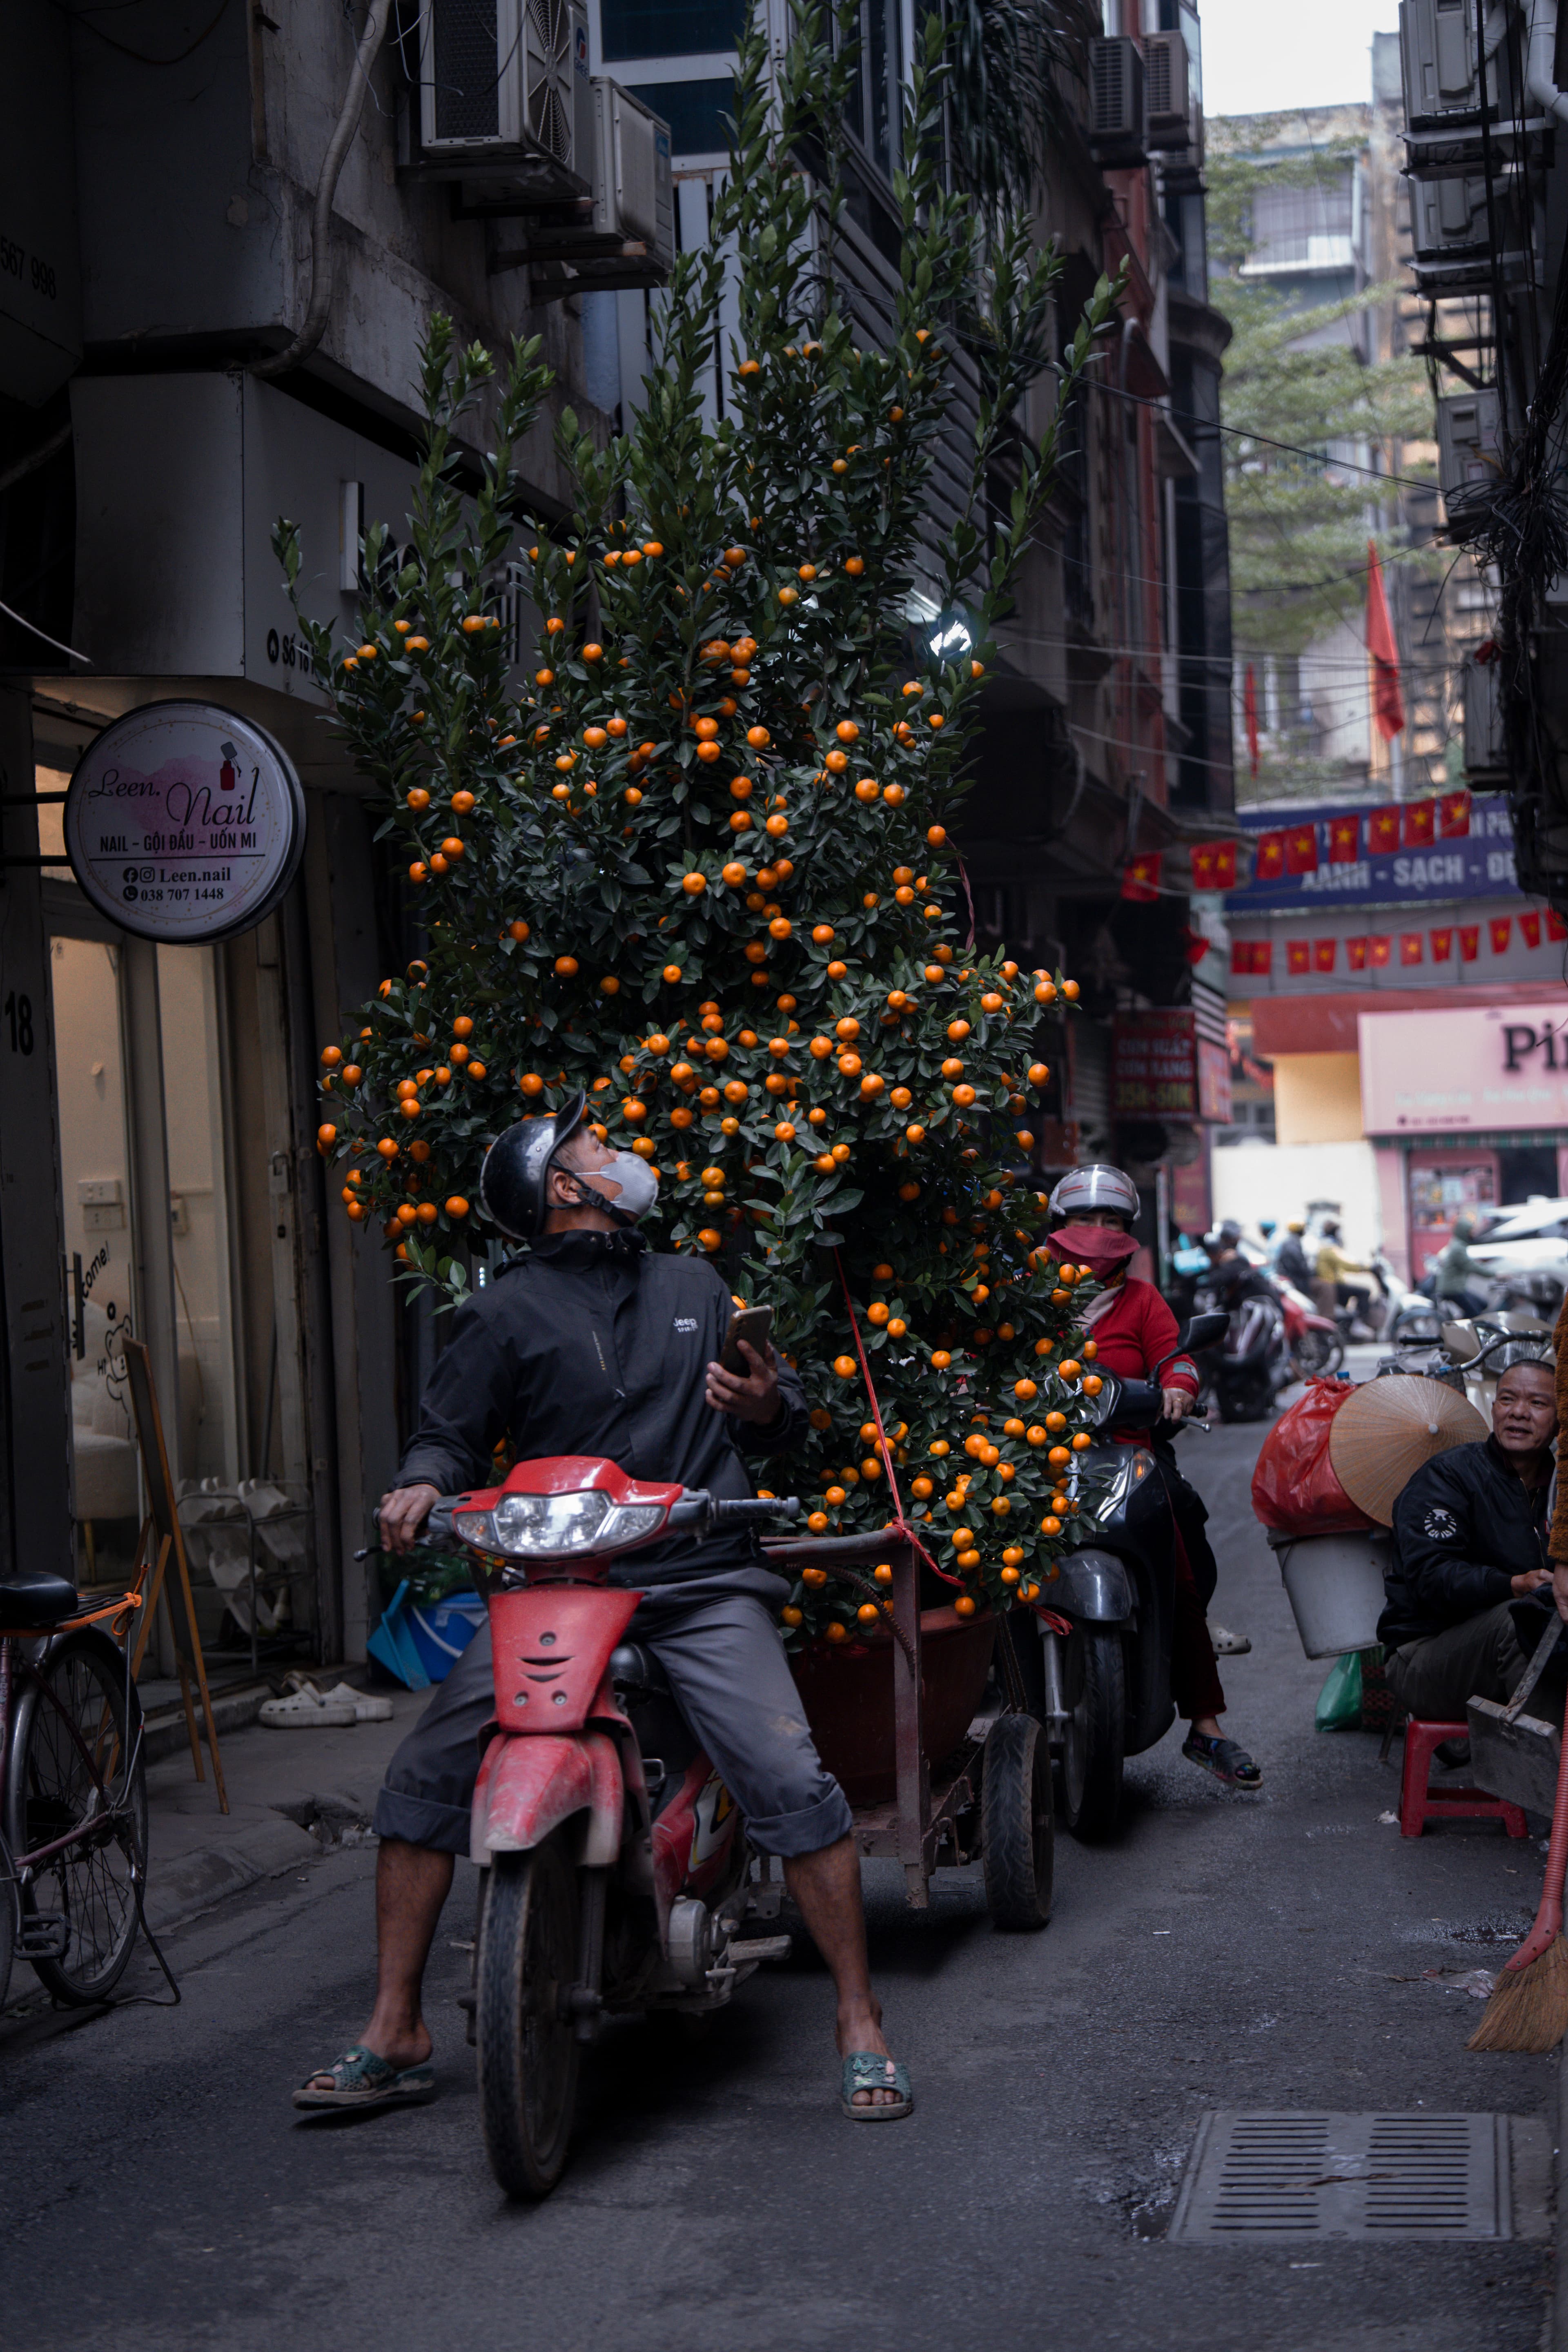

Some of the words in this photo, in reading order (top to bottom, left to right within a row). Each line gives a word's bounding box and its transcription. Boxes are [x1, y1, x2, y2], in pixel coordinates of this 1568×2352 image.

[1, 235, 25, 280] 567
[31, 256, 56, 300] 998
[282, 633, 296, 667] Số
[300, 641, 309, 673] 18
[88, 768, 160, 798] Leen.
[166, 767, 260, 826] Nail
[100, 835, 128, 852] NAIL
[144, 831, 165, 853] GỘI
[169, 828, 194, 850] ĐẦU
[210, 827, 236, 849] UỐN
[240, 832, 256, 848] MI
[160, 867, 231, 883] Leen.nail
[1393, 854, 1464, 891] SẠCH
[141, 889, 163, 902] 038
[168, 888, 189, 901] 707
[195, 887, 224, 900] 1448
[5, 991, 33, 1056] 18
[1501, 1022, 1568, 1071] Pi
[673, 1317, 697, 1327] Jeep
